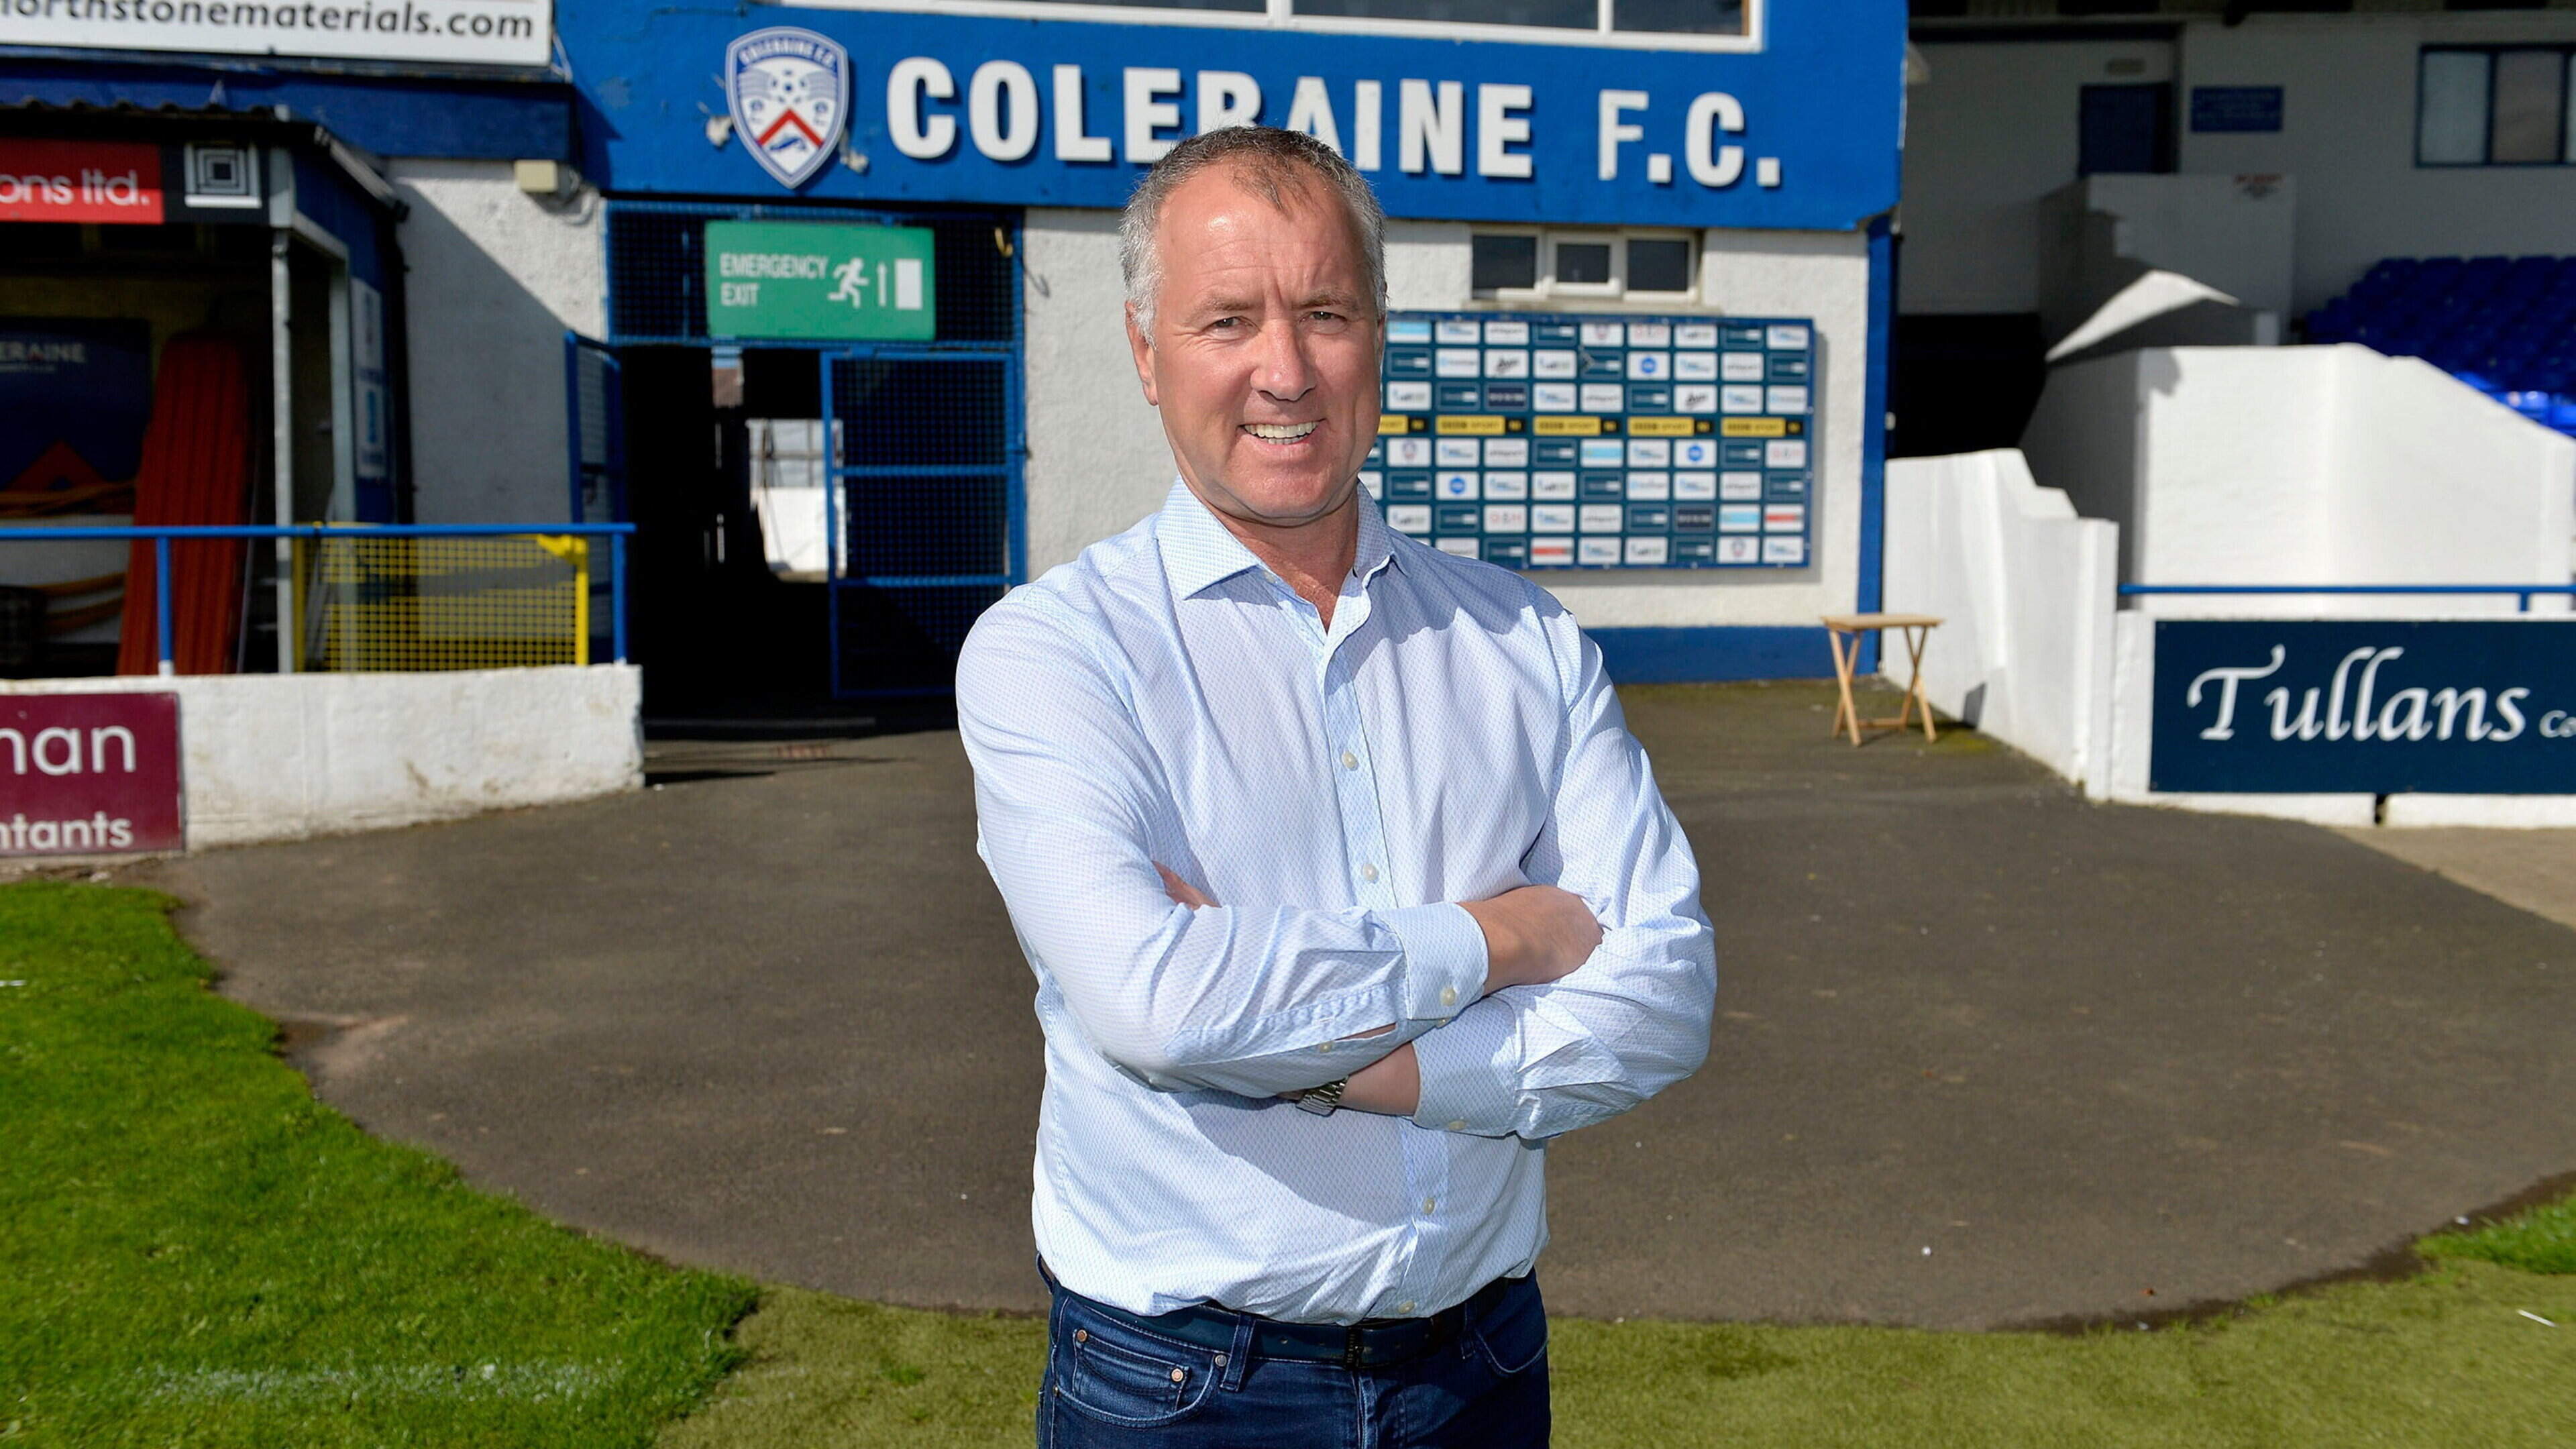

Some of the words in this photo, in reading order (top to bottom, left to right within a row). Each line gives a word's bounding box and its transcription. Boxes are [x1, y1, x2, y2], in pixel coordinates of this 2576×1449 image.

[886, 56, 1532, 178] COLERAINE
[1598, 89, 1780, 188] F.C.
[80, 168, 151, 206] ltd.
[720, 252, 829, 280] EMERGENCY
[720, 281, 760, 307] EXIT
[2186, 643, 2531, 742] Tullans
